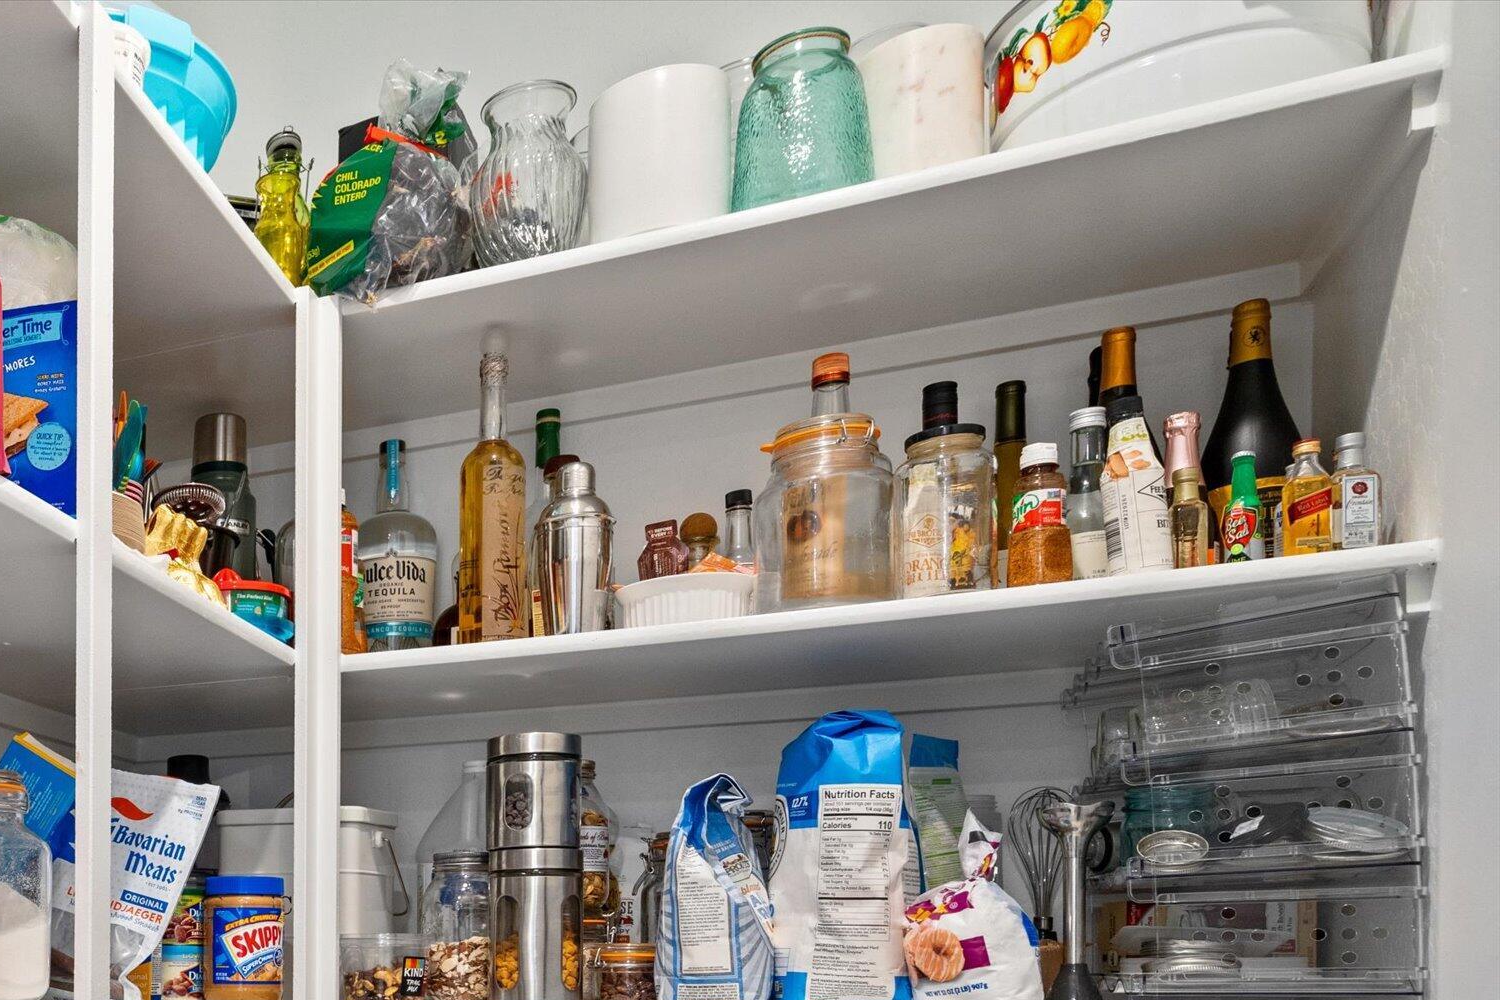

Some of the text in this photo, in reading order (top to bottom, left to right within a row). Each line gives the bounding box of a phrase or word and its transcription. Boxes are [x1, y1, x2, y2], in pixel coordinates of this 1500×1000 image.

[336, 170, 358, 184] CHILI
[334, 176, 381, 194] COLORADO
[334, 190, 368, 206] ENTERO
[18, 318, 52, 337] Time
[396, 560, 426, 583] Vida
[367, 587, 416, 598] TEQUILA
[824, 789, 896, 799] Nutrition Facts
[878, 821, 893, 830] 110
[112, 825, 187, 863] Bavarian
[124, 850, 179, 885] Meats
[124, 893, 165, 912] ORIGINAL
[225, 917, 249, 932] EXTRA
[403, 968, 424, 978] KIND
[971, 982, 989, 990] 907g
